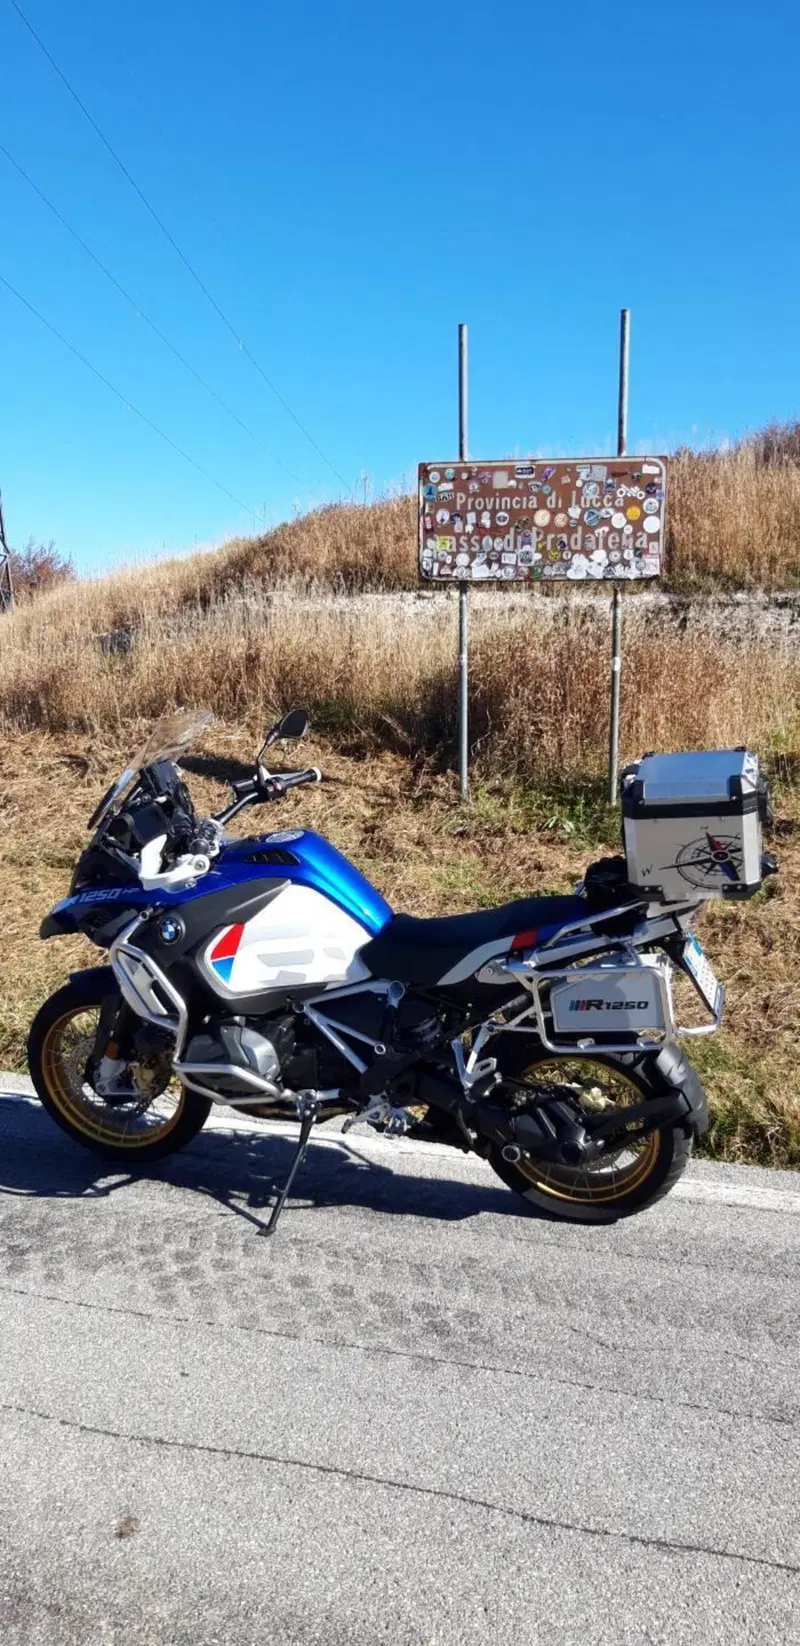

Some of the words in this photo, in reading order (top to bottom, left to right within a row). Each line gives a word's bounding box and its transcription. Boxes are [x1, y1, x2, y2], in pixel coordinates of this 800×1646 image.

[456, 492, 538, 510] Provincia
[546, 489, 562, 509] di
[79, 889, 120, 902] 1250
[585, 999, 649, 1011] R1250
